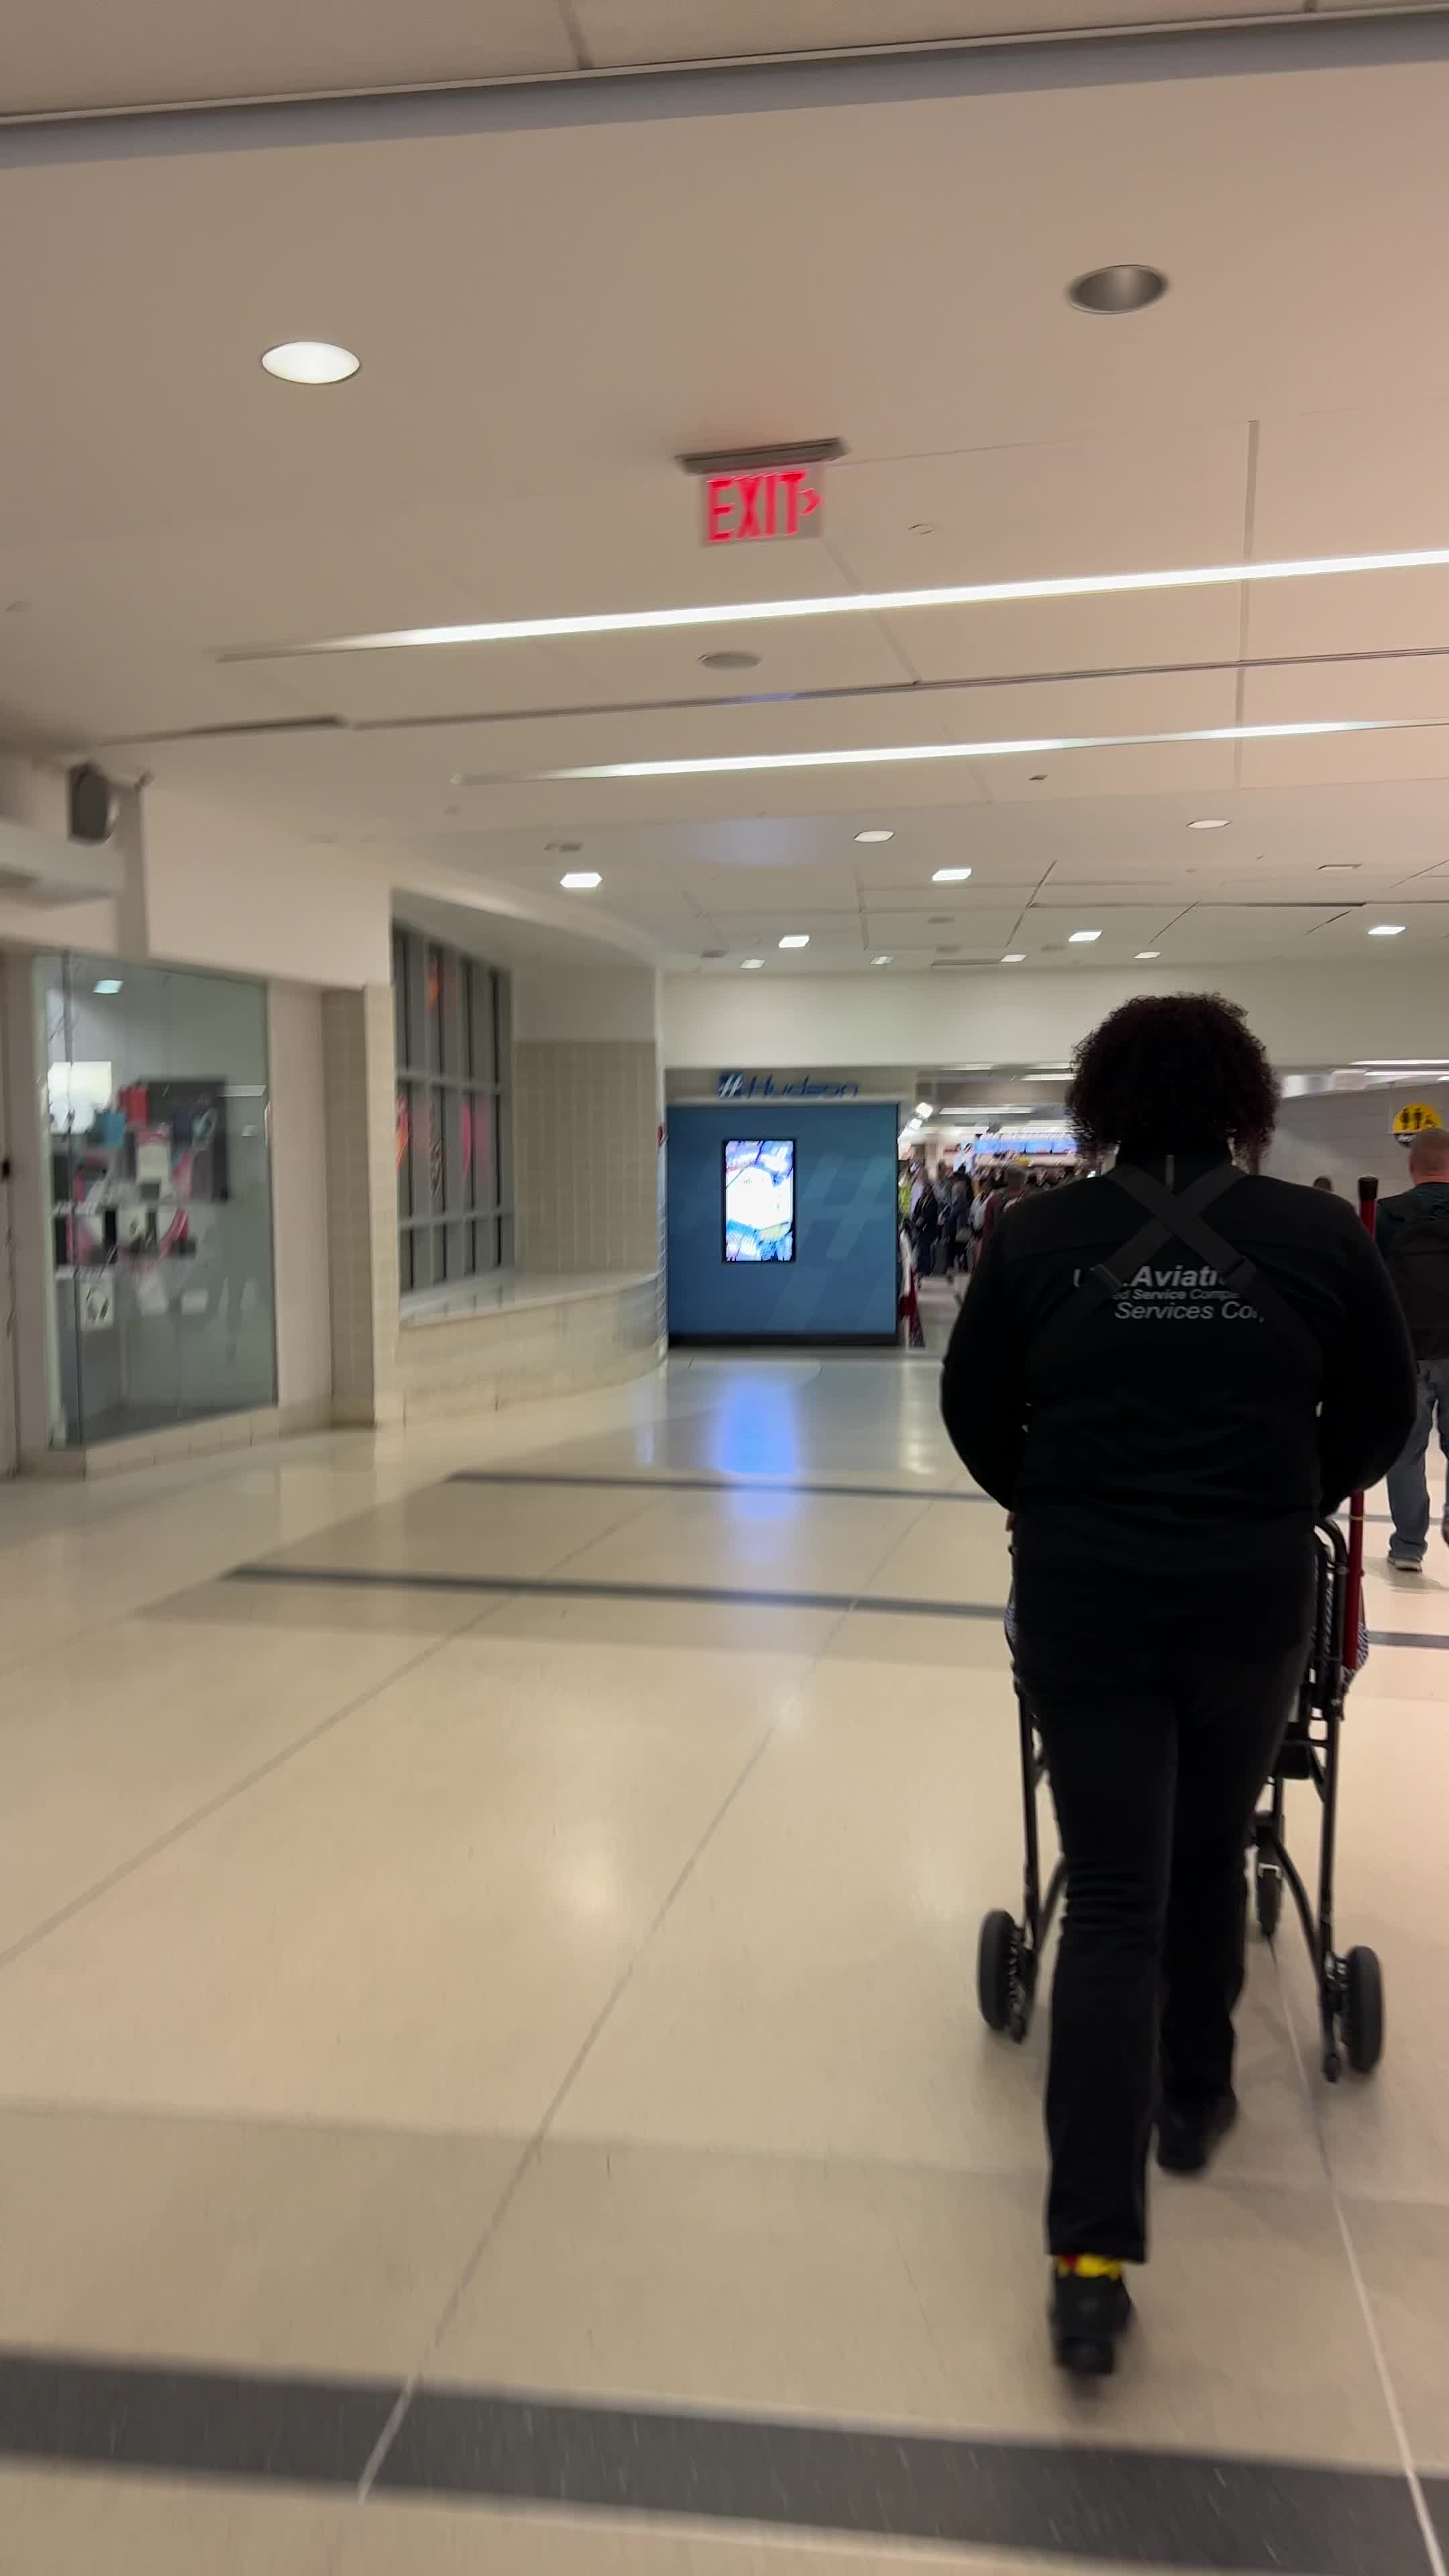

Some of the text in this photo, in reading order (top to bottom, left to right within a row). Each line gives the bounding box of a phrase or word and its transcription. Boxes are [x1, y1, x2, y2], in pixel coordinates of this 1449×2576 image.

[708, 472, 807, 542] EXIT
[1131, 1266, 1224, 1287] Aviati
[1133, 1289, 1186, 1299] Service
[1115, 1301, 1213, 1319] Services
